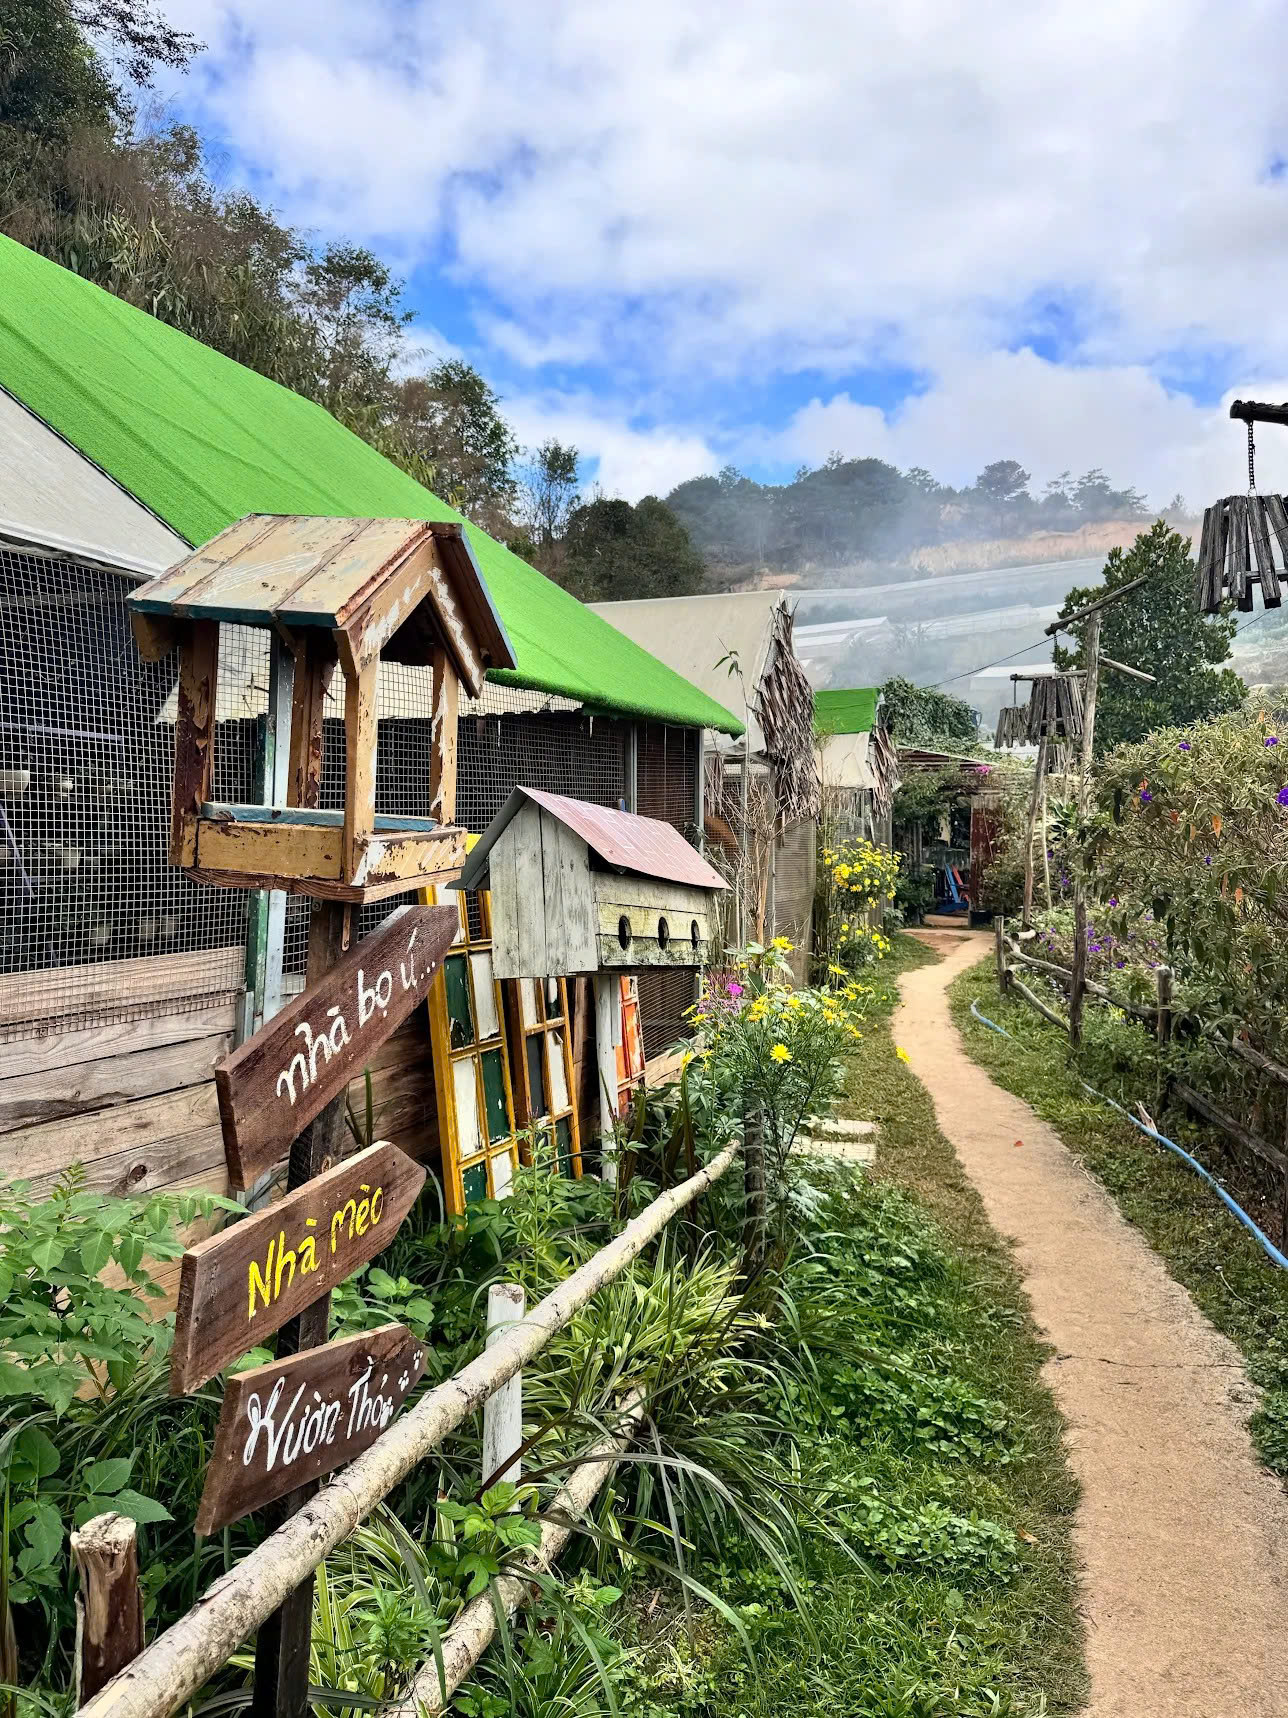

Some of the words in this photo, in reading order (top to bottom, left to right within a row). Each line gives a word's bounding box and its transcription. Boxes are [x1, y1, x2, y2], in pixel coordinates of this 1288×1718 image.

[276, 1005, 352, 1106] nhà
[357, 968, 392, 1028] bọ
[248, 1218, 321, 1322] Nhà
[243, 1376, 341, 1472] Vườn
